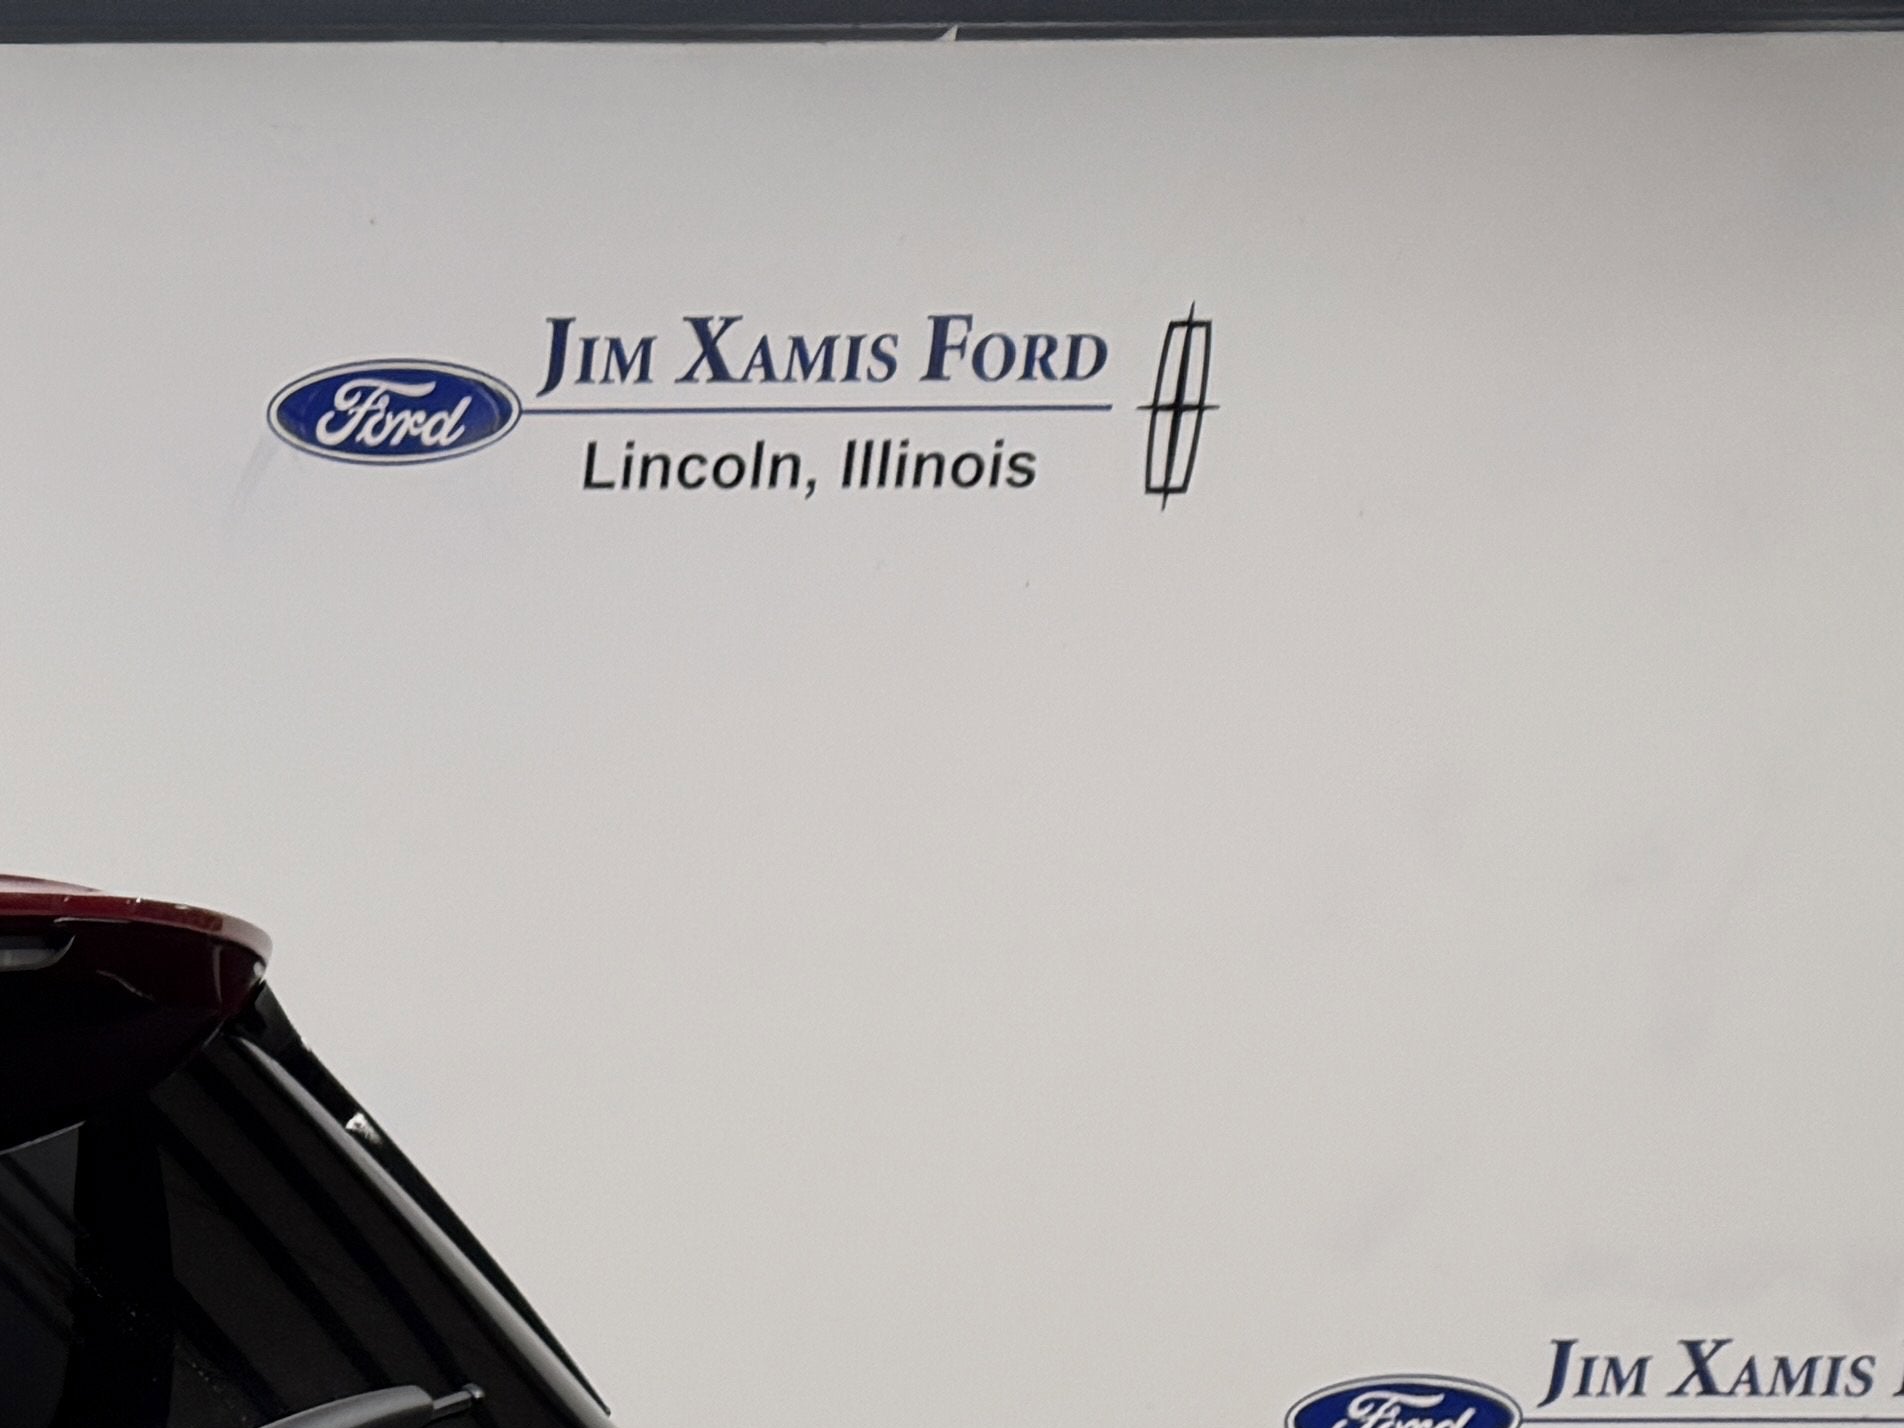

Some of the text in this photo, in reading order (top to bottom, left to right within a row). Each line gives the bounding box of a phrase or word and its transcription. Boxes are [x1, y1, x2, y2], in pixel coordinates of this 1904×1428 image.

[537, 313, 1110, 396] JIM XAMIS FORD
[314, 378, 467, 450] Ford
[582, 439, 1037, 499] Lincoln, Illinois
[1536, 1338, 1653, 1408] JIM
[1667, 1337, 1877, 1398] XAMIS
